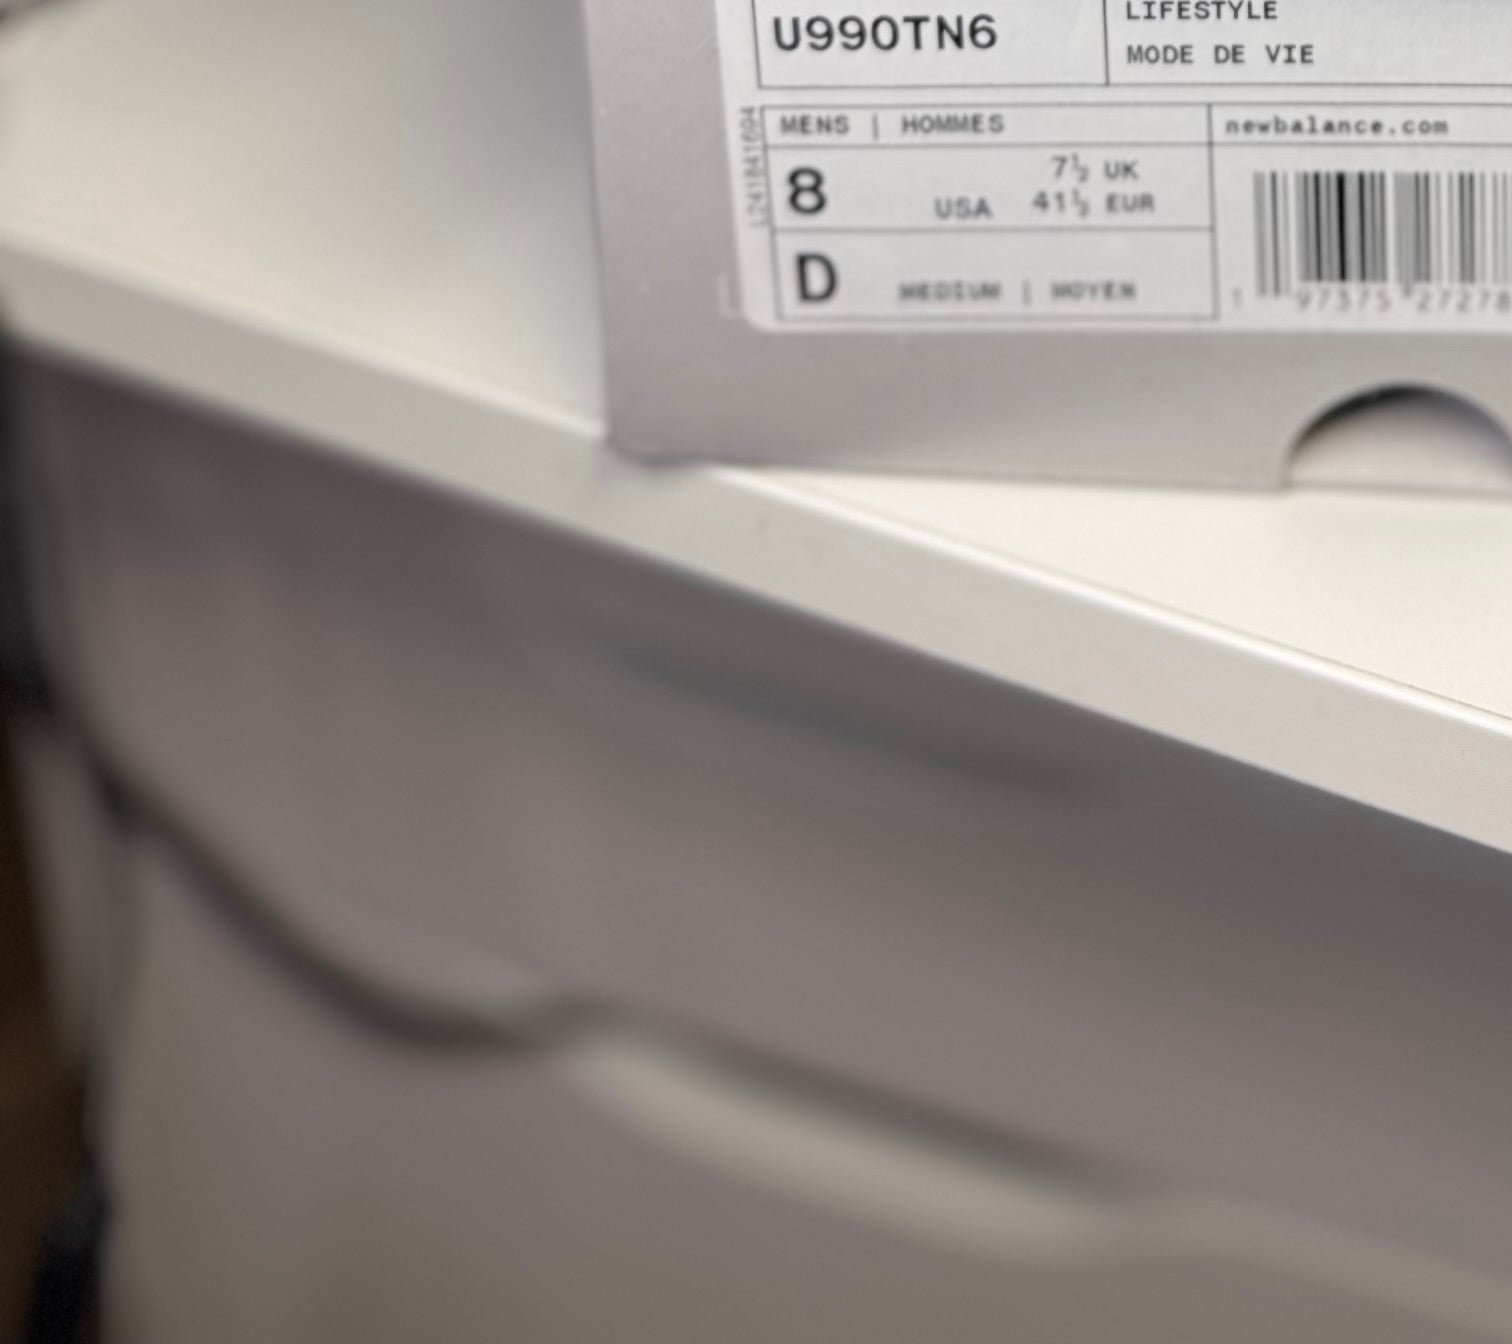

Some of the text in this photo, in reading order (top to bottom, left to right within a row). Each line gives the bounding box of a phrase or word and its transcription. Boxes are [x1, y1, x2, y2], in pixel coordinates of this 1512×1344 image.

[1126, 0, 1279, 21] LIFESTYLE
[772, 13, 999, 52] U990TN6
[1126, 44, 1315, 66] MODE DE VIE
[780, 114, 1005, 135] MENS HOMMES
[1225, 115, 1449, 136] newbalance.com
[1104, 160, 1139, 180] UK
[786, 166, 828, 216] 8
[934, 198, 992, 220] USA
[1105, 192, 1155, 214] EUR
[794, 252, 839, 304] D
[898, 279, 1137, 302] MEDIUM MOYEN
